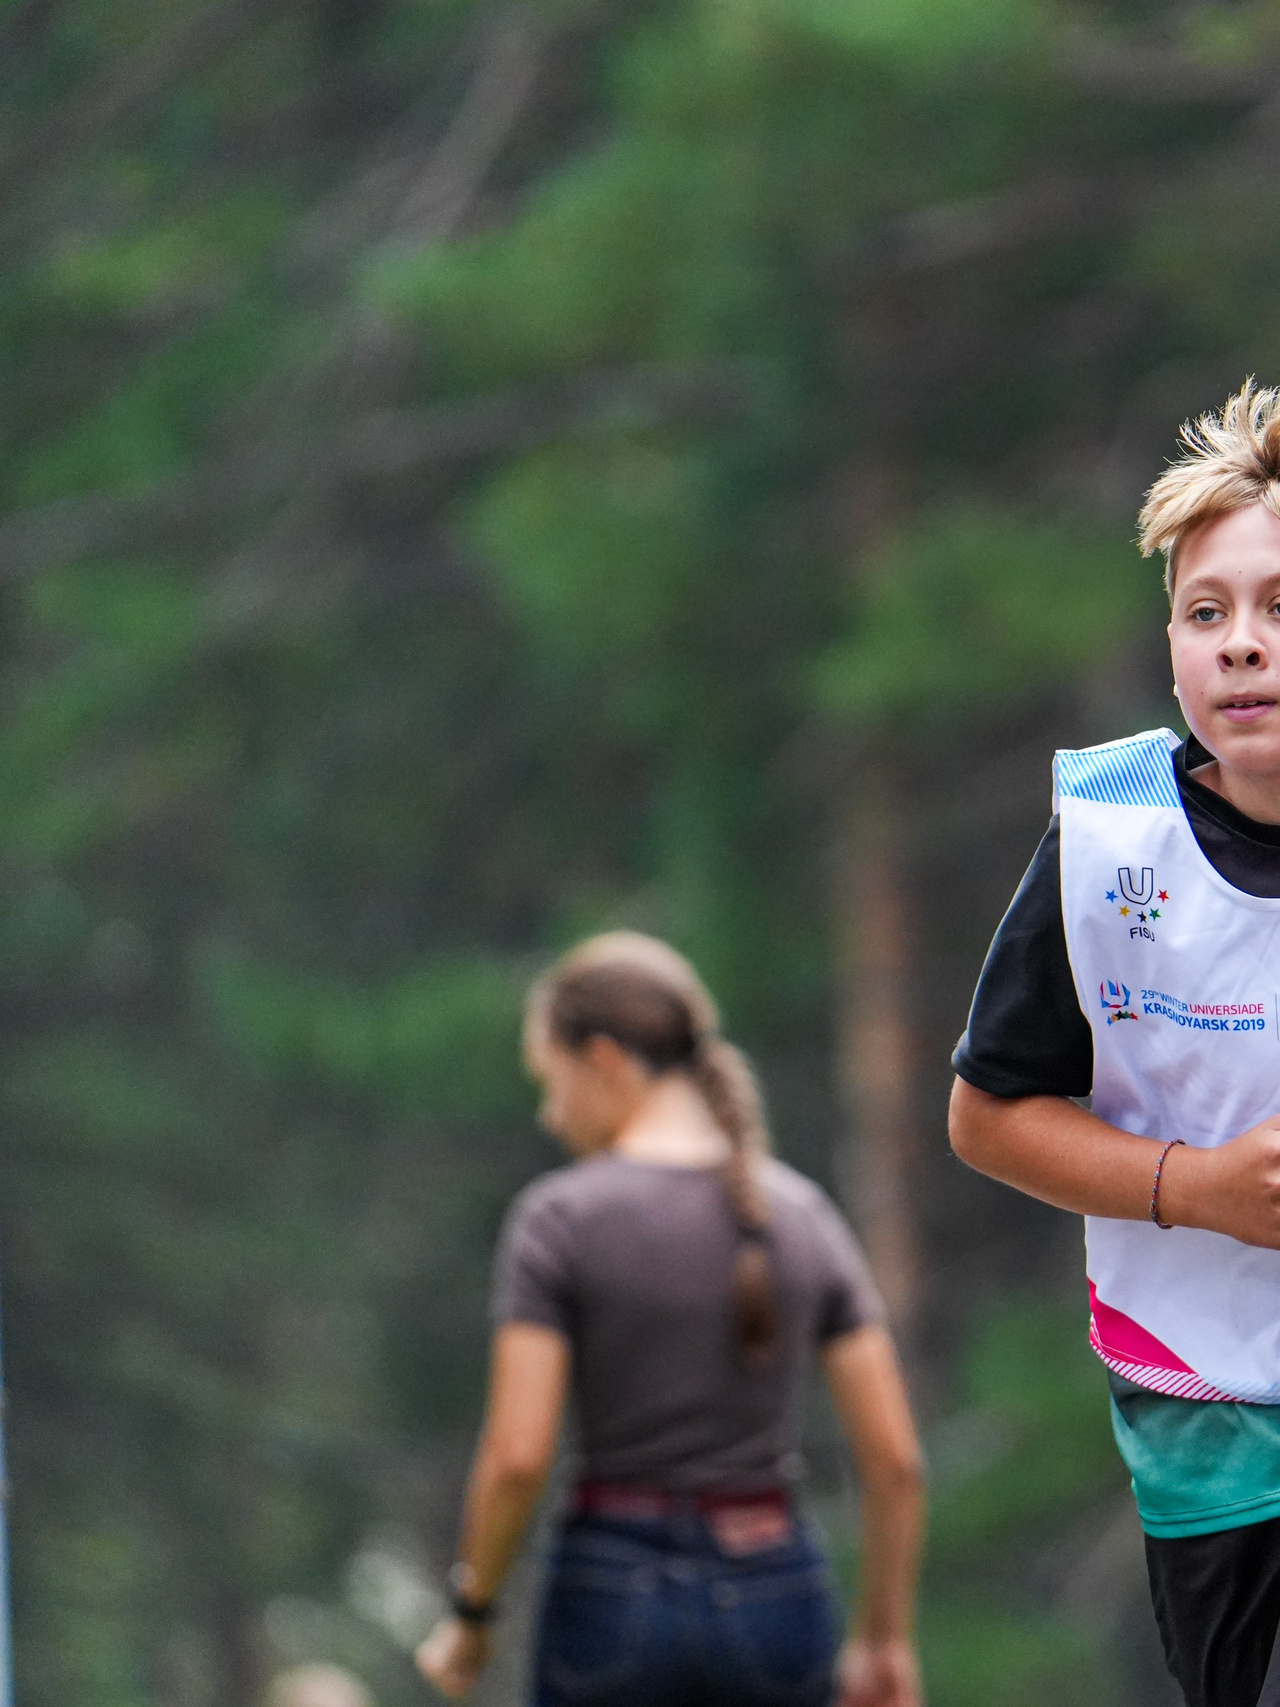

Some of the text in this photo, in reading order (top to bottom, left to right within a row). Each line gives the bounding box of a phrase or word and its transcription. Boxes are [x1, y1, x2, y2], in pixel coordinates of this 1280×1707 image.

[1129, 926, 1156, 942] FISU
[1159, 991, 1189, 1012] WINTER
[1189, 1003, 1265, 1016] UNIVERSIADE
[1143, 1003, 1266, 1031] KRASNOYARSK 2019
